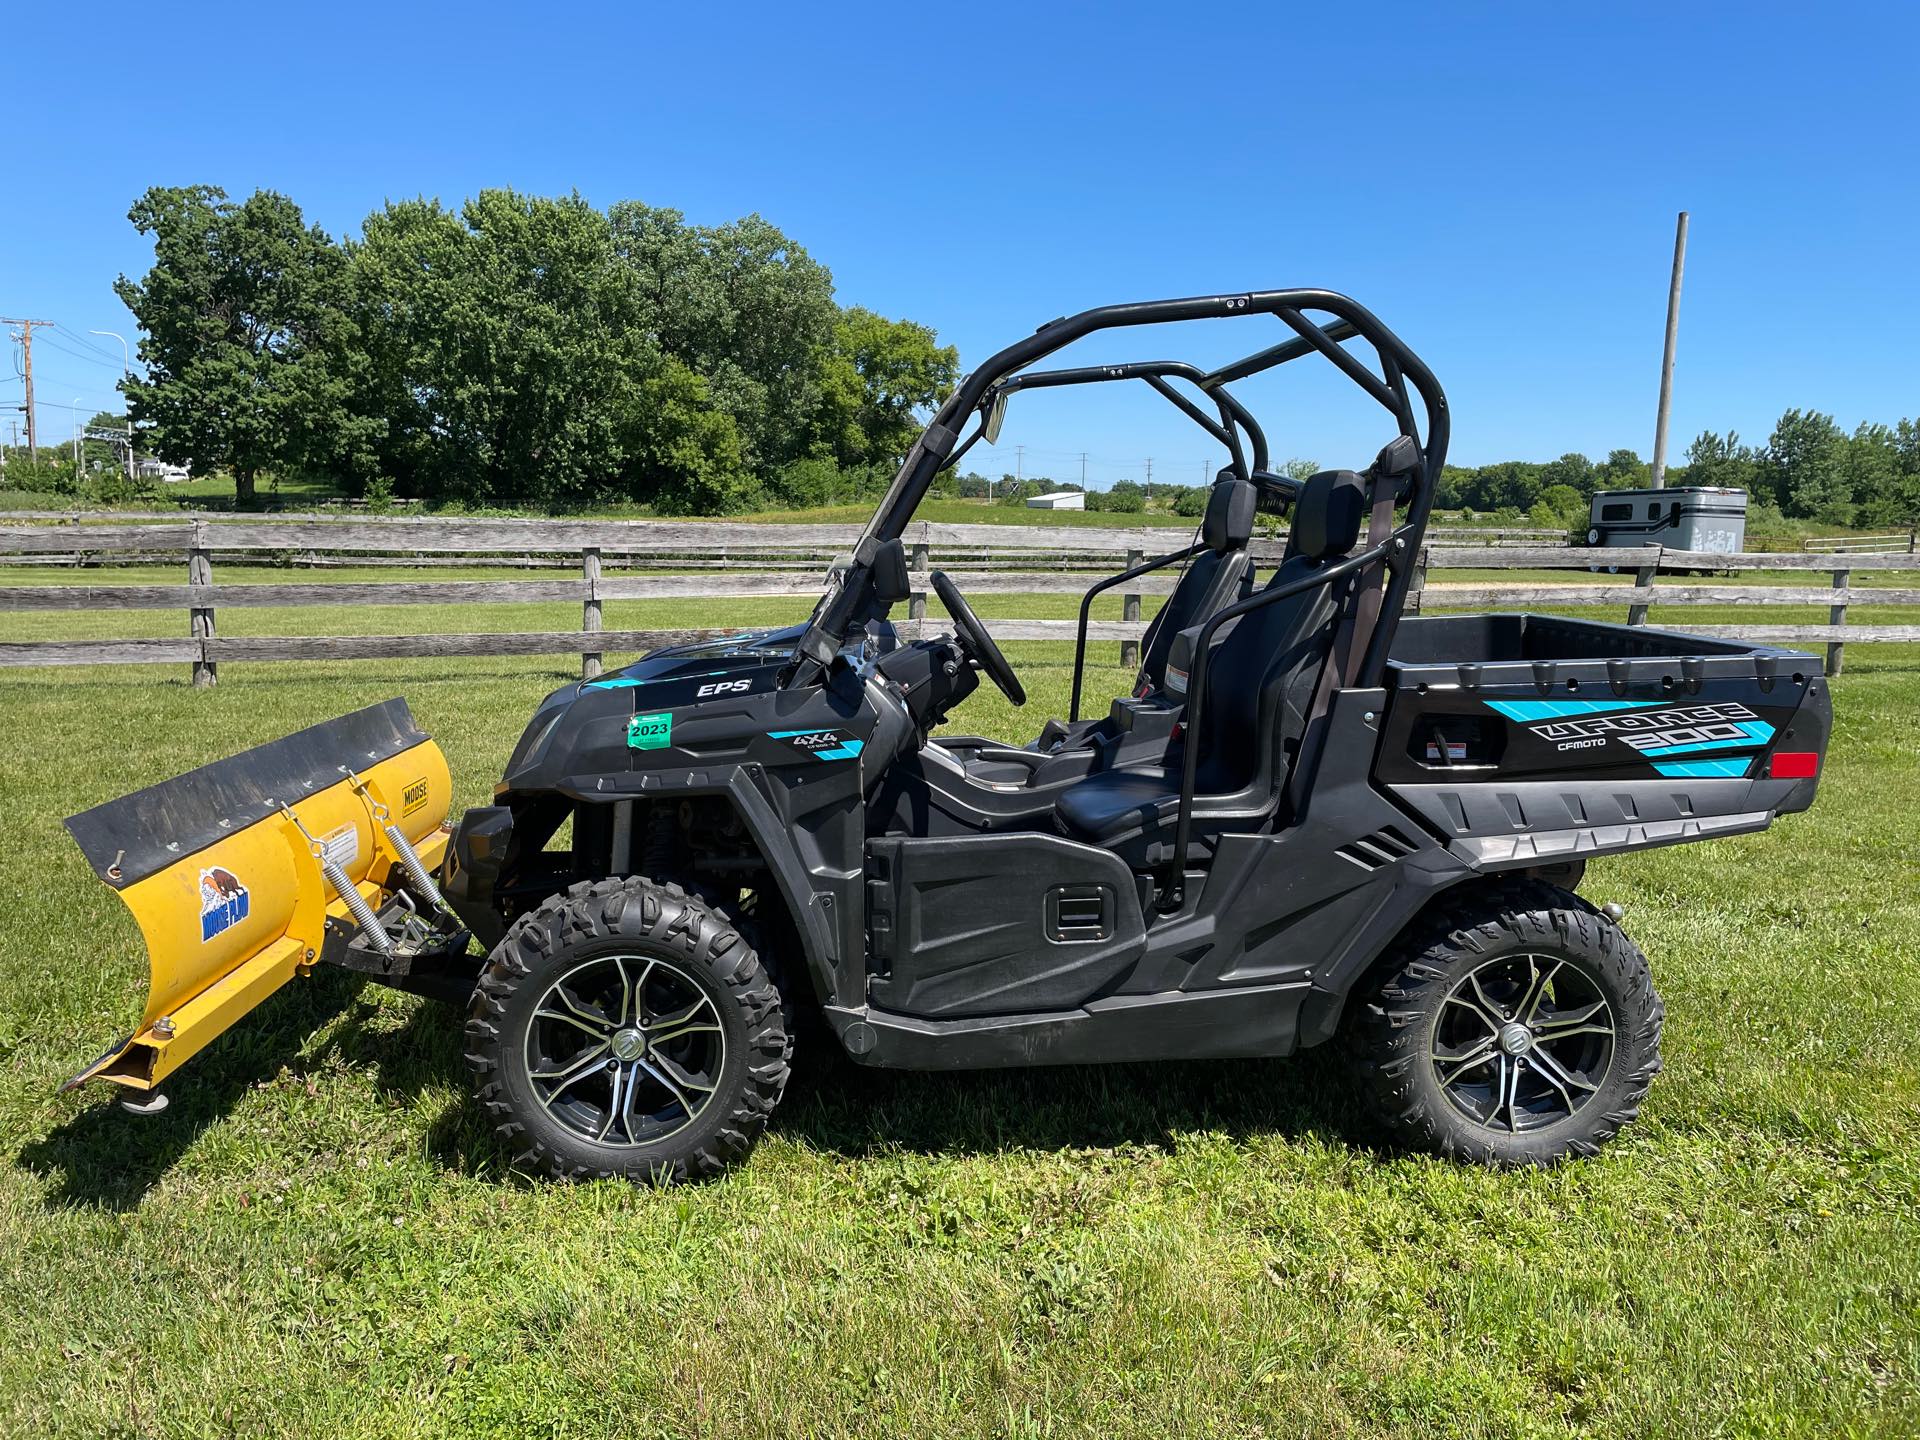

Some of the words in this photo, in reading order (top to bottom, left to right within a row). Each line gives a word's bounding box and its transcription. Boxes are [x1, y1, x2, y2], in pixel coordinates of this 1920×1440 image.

[697, 679, 751, 697] EPS
[632, 723, 668, 737] 2023
[1528, 702, 1758, 741] UFORCE
[1558, 738, 1606, 750] CFMOTO
[1617, 723, 1750, 750] 800
[404, 781, 427, 807] MOOSE
[202, 902, 229, 942] MOOSE
